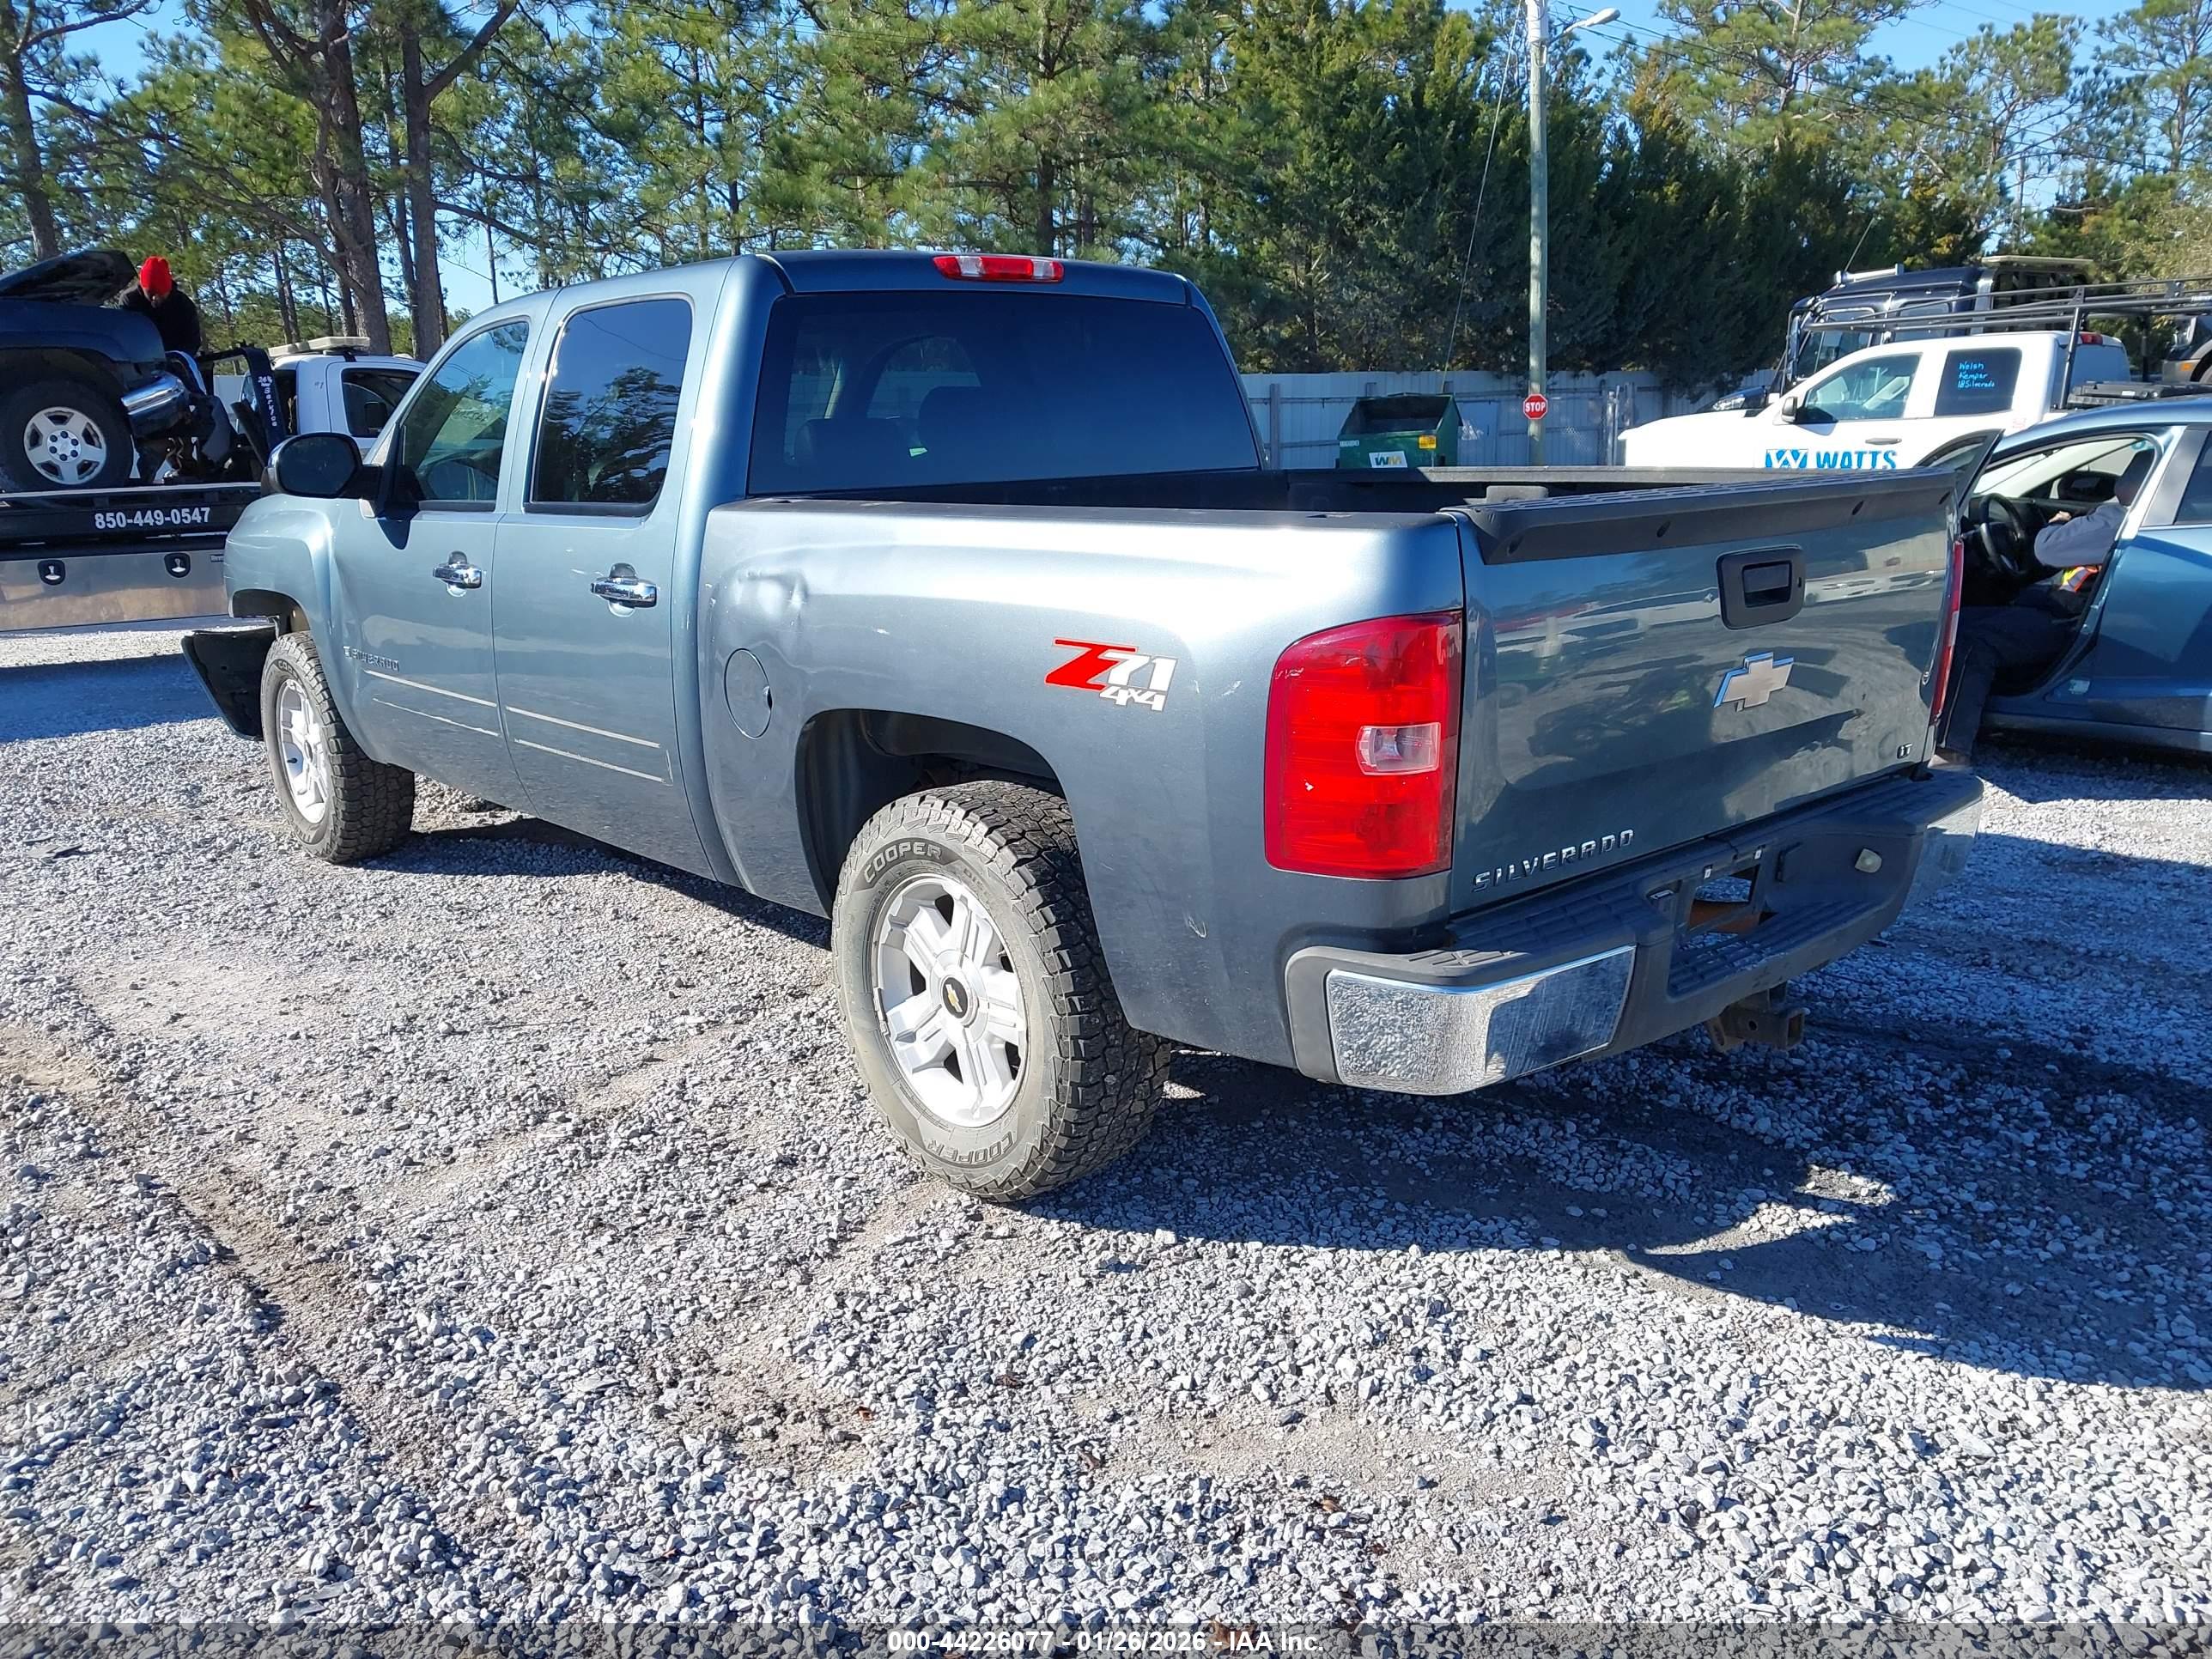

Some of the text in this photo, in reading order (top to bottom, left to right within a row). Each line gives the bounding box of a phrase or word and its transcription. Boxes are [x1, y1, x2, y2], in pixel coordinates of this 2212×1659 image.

[1525, 402, 1546, 412] STOP
[1816, 450, 1897, 470] WATTS
[94, 507, 210, 529] 850-449-0547
[1044, 637, 1178, 692] Z71
[864, 842, 943, 883] COOPER
[1473, 829, 1633, 892] SILVERADO
[927, 1131, 1013, 1164] COOPER
